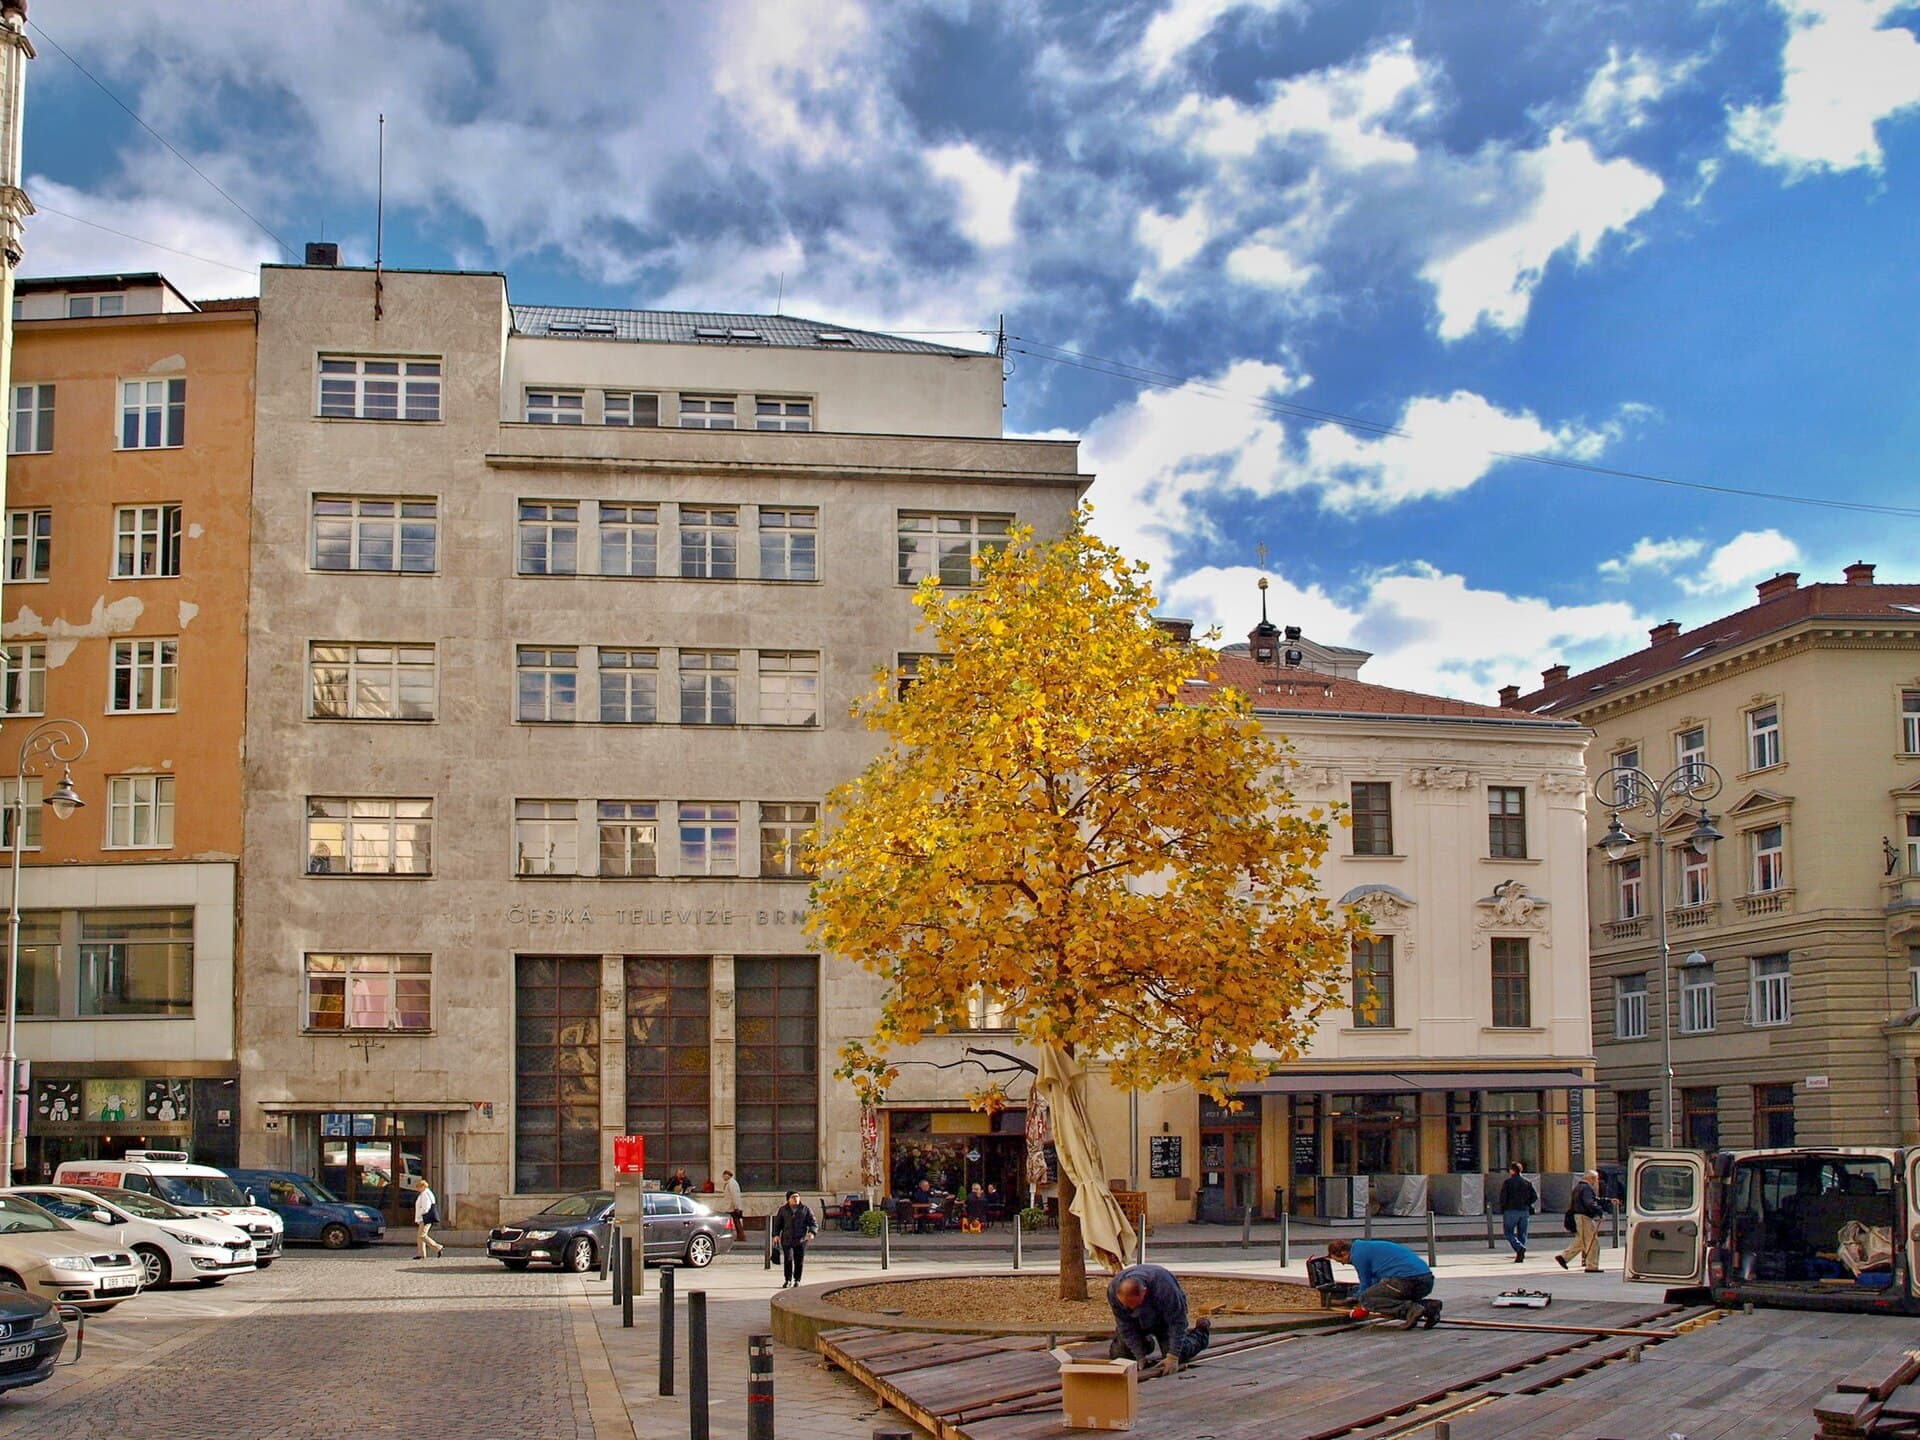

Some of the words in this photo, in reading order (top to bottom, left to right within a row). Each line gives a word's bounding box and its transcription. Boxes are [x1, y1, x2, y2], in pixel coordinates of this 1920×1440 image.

[507, 904, 594, 925] ČESKÁ
[616, 909, 733, 925] TELEVIZE
[757, 909, 824, 925] BRN
